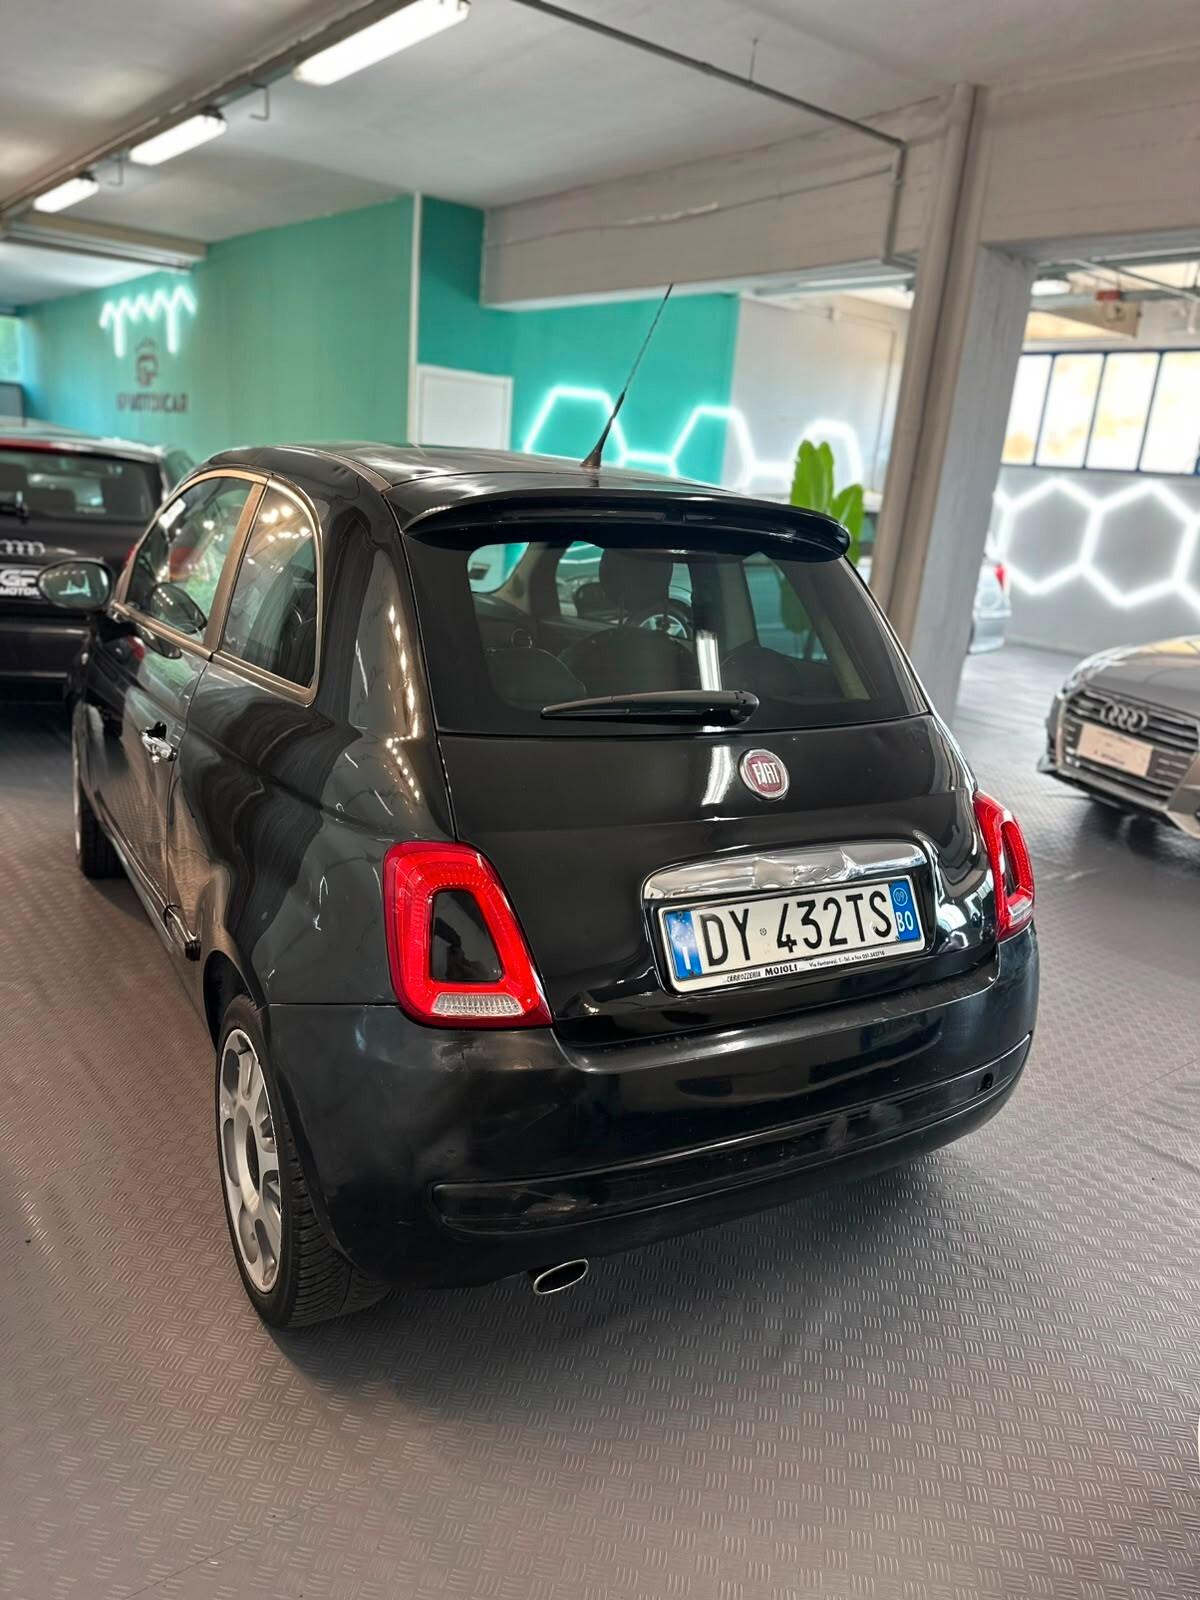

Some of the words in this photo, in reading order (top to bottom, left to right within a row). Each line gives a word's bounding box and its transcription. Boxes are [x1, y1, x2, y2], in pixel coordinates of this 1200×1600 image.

[751, 761, 779, 785] FIAT
[700, 908, 750, 966] DY
[777, 891, 892, 952] 432TS
[897, 911, 914, 932] BO
[765, 964, 797, 976] MOIOLI
